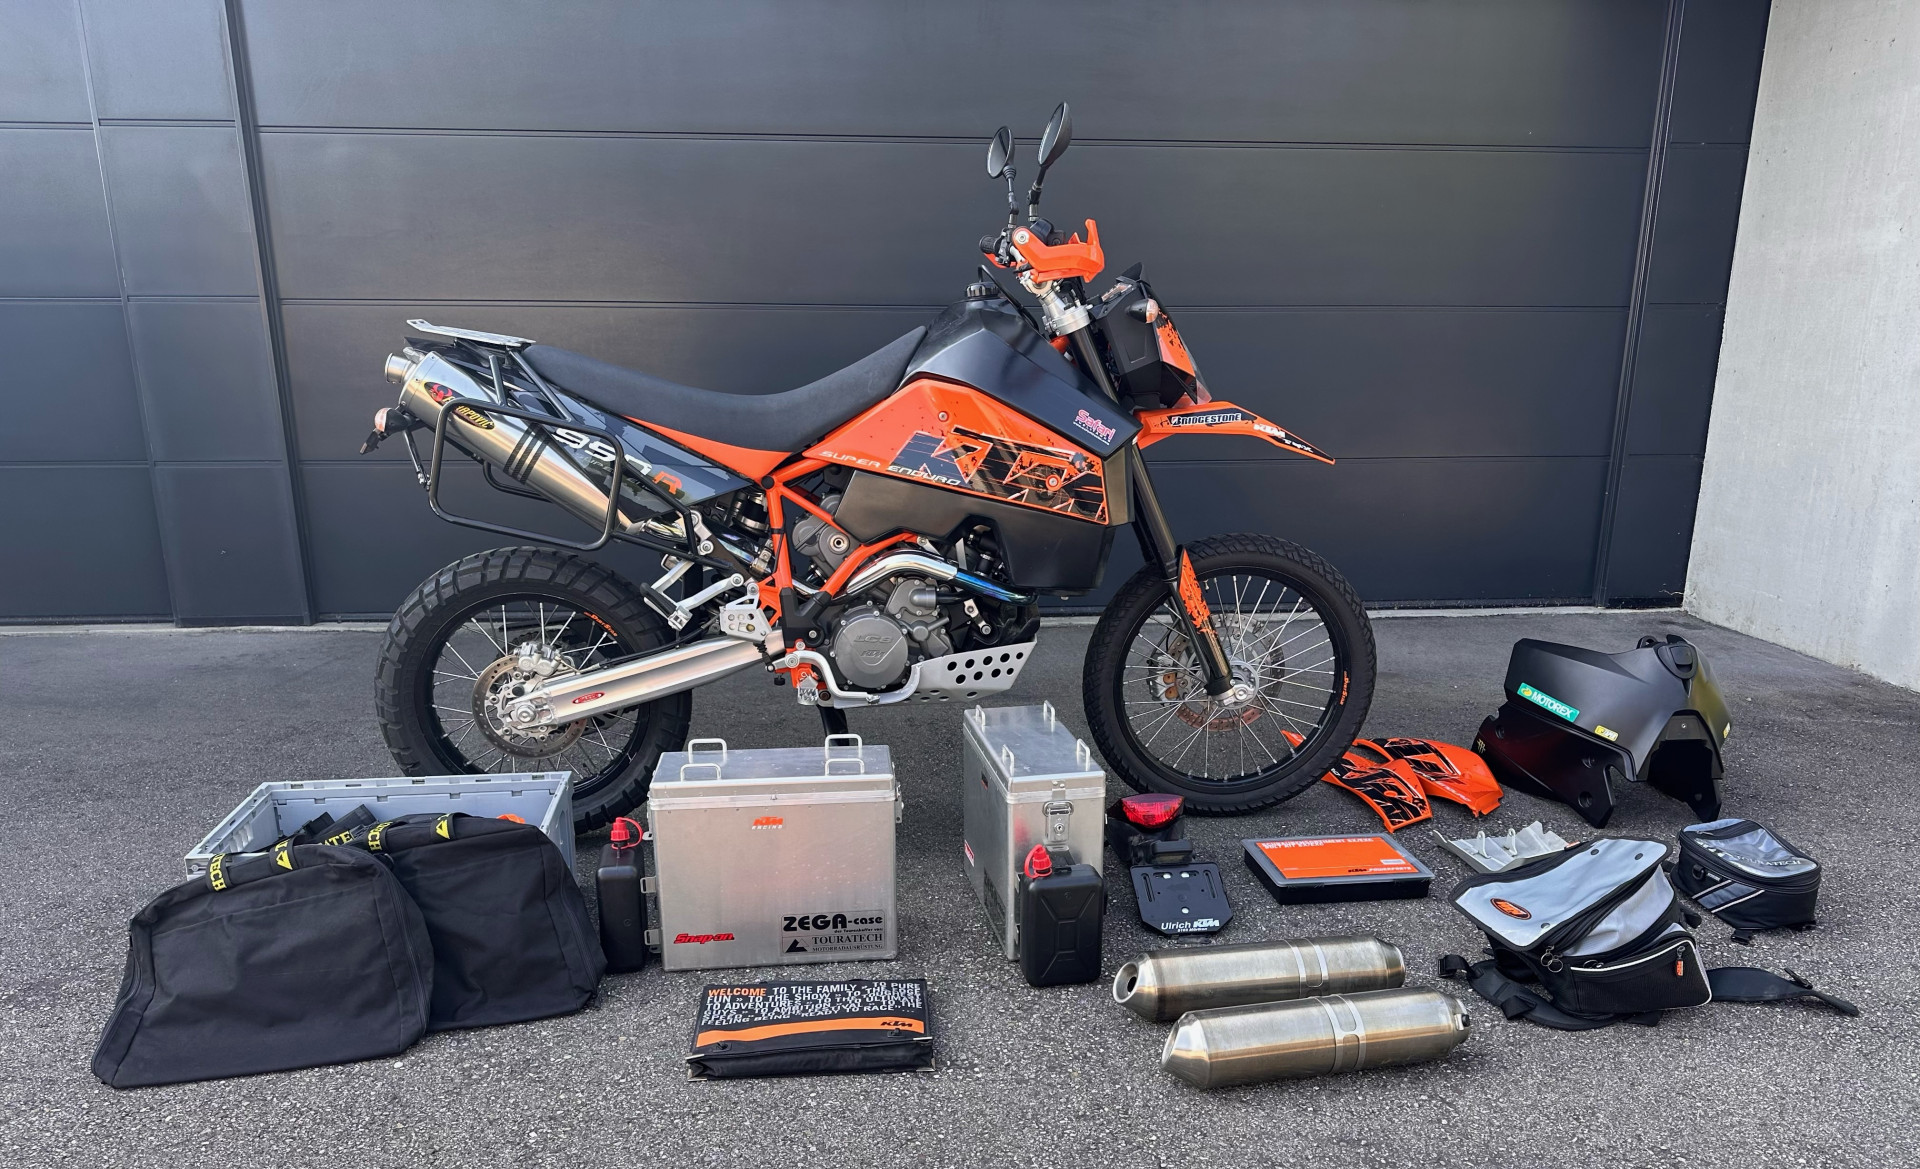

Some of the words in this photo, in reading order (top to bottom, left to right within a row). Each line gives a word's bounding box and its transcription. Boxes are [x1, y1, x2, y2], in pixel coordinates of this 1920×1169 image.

[1076, 409, 1116, 440] Safari
[1171, 413, 1241, 426] BRIDGESTONE
[1254, 424, 1286, 438] KTM
[819, 450, 881, 468] SUPER
[886, 465, 961, 486] ENDURO
[652, 471, 683, 495] R
[1531, 691, 1574, 719] MOTOREX
[752, 816, 784, 825] KTM
[1161, 921, 1191, 930] Ulrich
[1193, 918, 1219, 928] KTM
[673, 933, 735, 944] Snap-on
[812, 934, 882, 945] TOURATECH
[708, 987, 767, 997] WELCOME
[773, 986, 787, 995] TO
[791, 985, 813, 994] THE
[816, 983, 857, 994] FAMILY
[707, 995, 731, 1004] FUN
[748, 995, 763, 1003] TO
[768, 993, 790, 1001] THE
[794, 992, 830, 1001] SHOW
[706, 1002, 720, 1010] TO
[724, 1000, 801, 1010] ADVENTURES
[701, 1018, 750, 1026] FEELING
